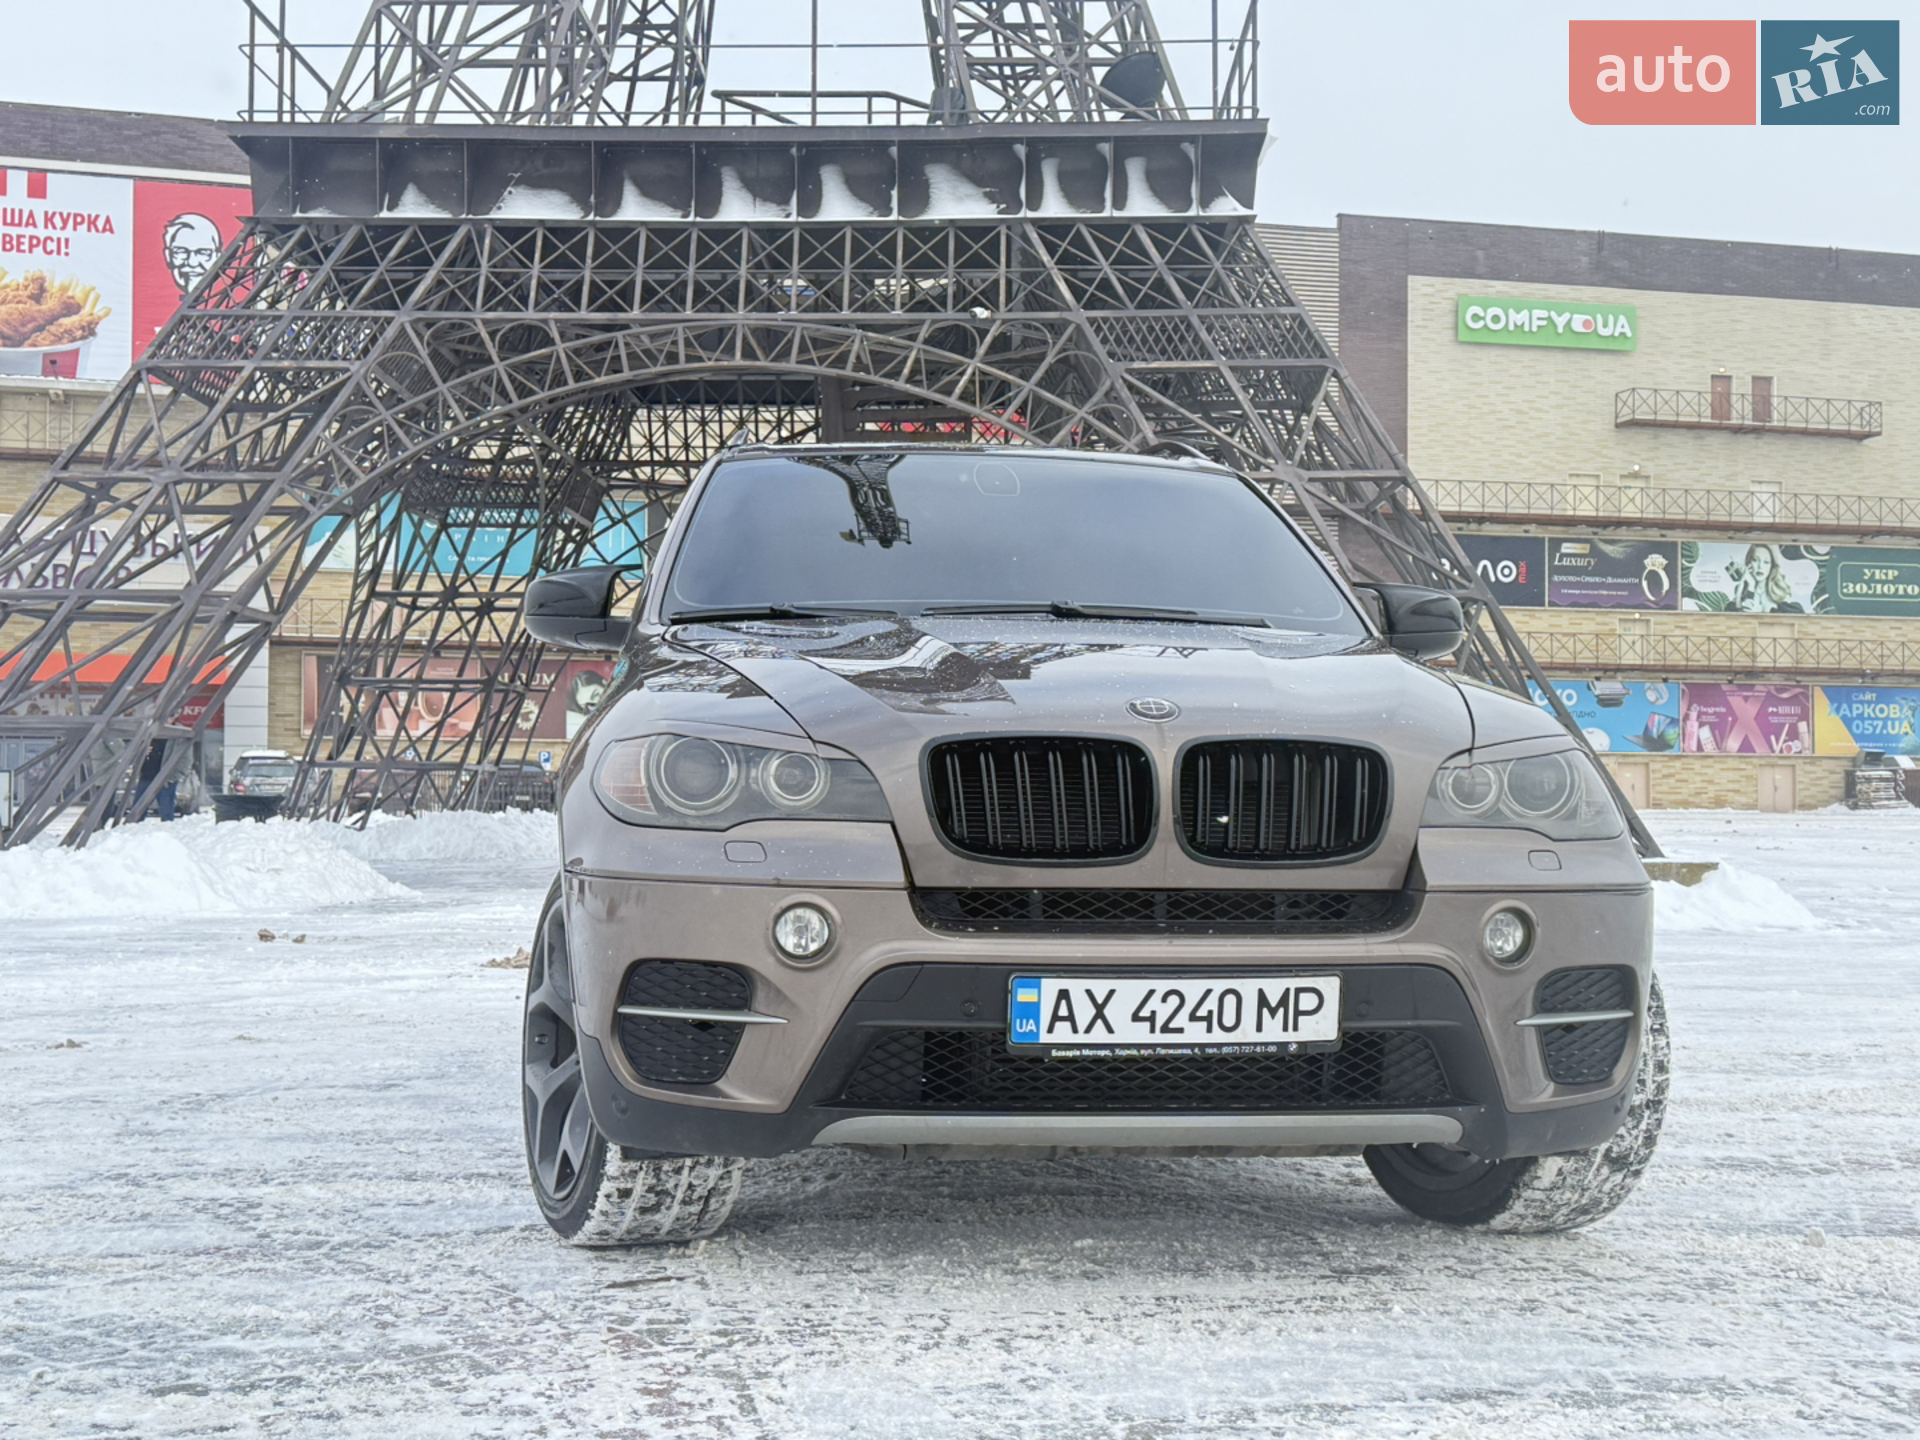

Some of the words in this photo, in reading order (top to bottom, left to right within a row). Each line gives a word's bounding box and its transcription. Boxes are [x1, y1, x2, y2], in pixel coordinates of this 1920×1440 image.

[43, 210, 115, 235] КУРКА
[1465, 305, 1571, 334] COMFY
[1596, 313, 1632, 338] UA
[1553, 553, 1598, 570] Luxury
[1862, 568, 1899, 580] УКР
[1842, 582, 1919, 595] ЗОЛОТО
[1851, 691, 1878, 701] САЙТ
[1851, 719, 1914, 735] 057.UA
[1046, 988, 1117, 1034] AX
[1131, 988, 1243, 1034] 4240
[1256, 987, 1325, 1033] MP
[1016, 1018, 1037, 1033] UA
